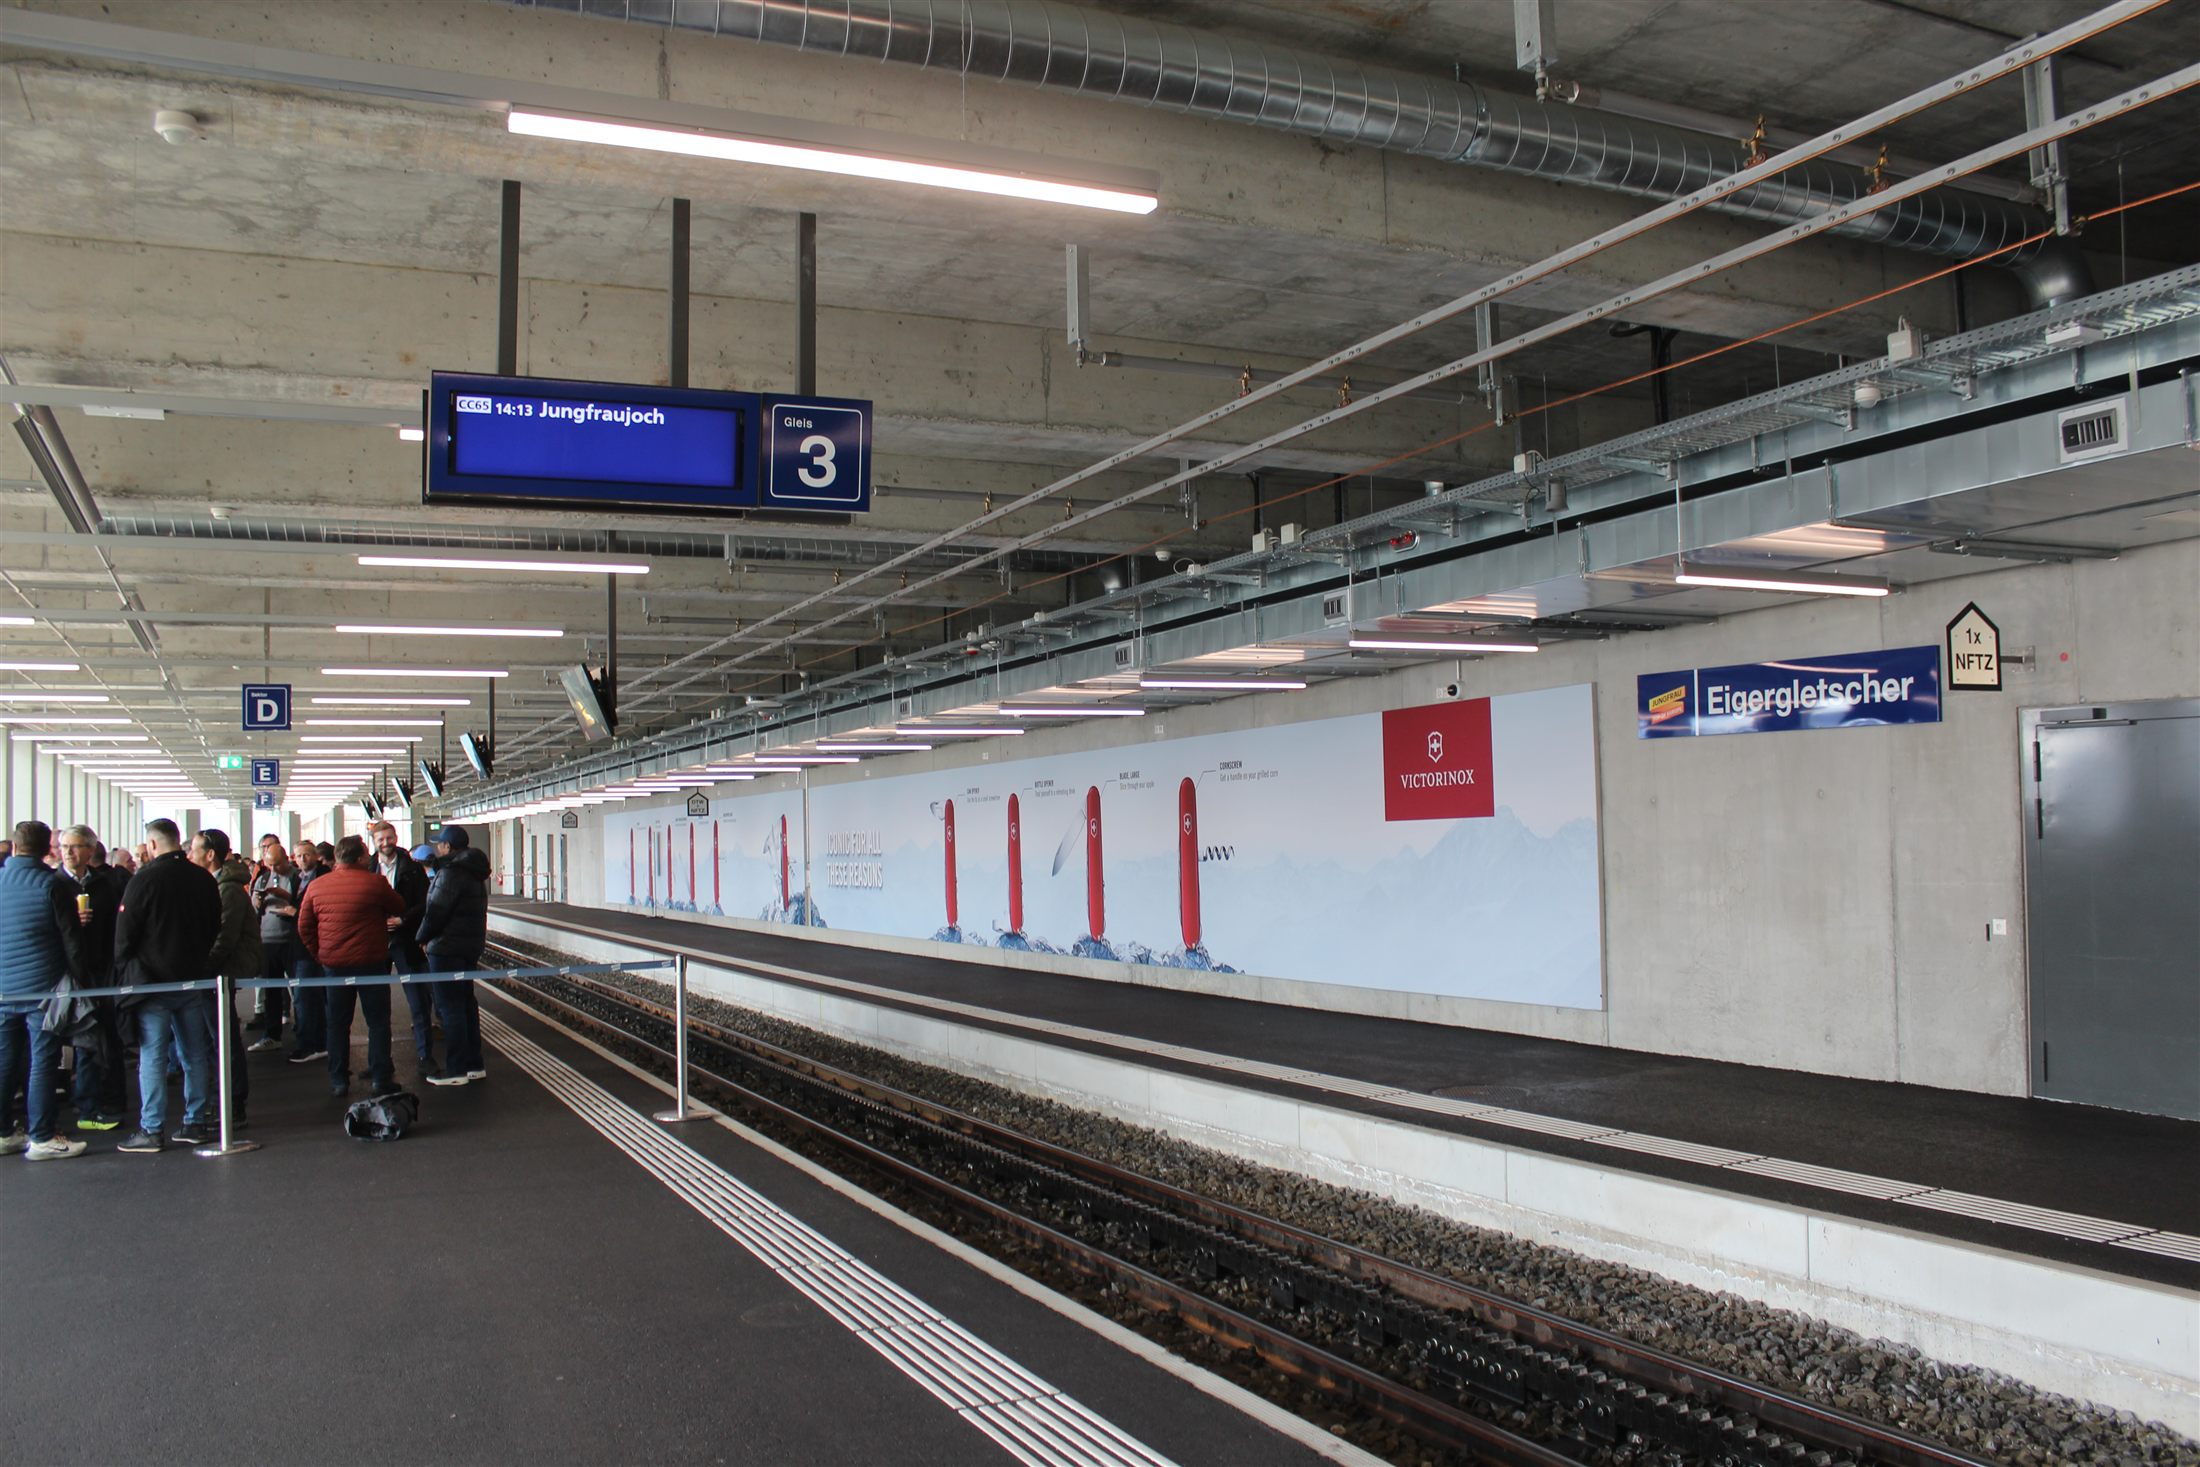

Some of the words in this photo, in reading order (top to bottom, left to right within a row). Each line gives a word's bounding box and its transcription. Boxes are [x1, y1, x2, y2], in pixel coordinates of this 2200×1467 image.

[458, 399, 490, 411] CC65
[495, 402, 533, 417] 14:13
[539, 402, 665, 427] Jungfraujoch
[784, 416, 813, 429] Gleis
[798, 435, 837, 488] 3
[1965, 627, 1982, 645] 1x
[1955, 653, 1994, 671] NFTZ
[1651, 689, 1683, 708] JUNGFRAU
[1707, 672, 1915, 720] Eigergletscher
[257, 699, 279, 722] D
[260, 767, 271, 781] E
[1219, 760, 1243, 770] CORKSCREW
[1400, 768, 1475, 789] VICTORINOX
[261, 795, 268, 805] F
[851, 830, 867, 856] FOR
[826, 862, 848, 888] THESE
[849, 862, 883, 890] REASONS
